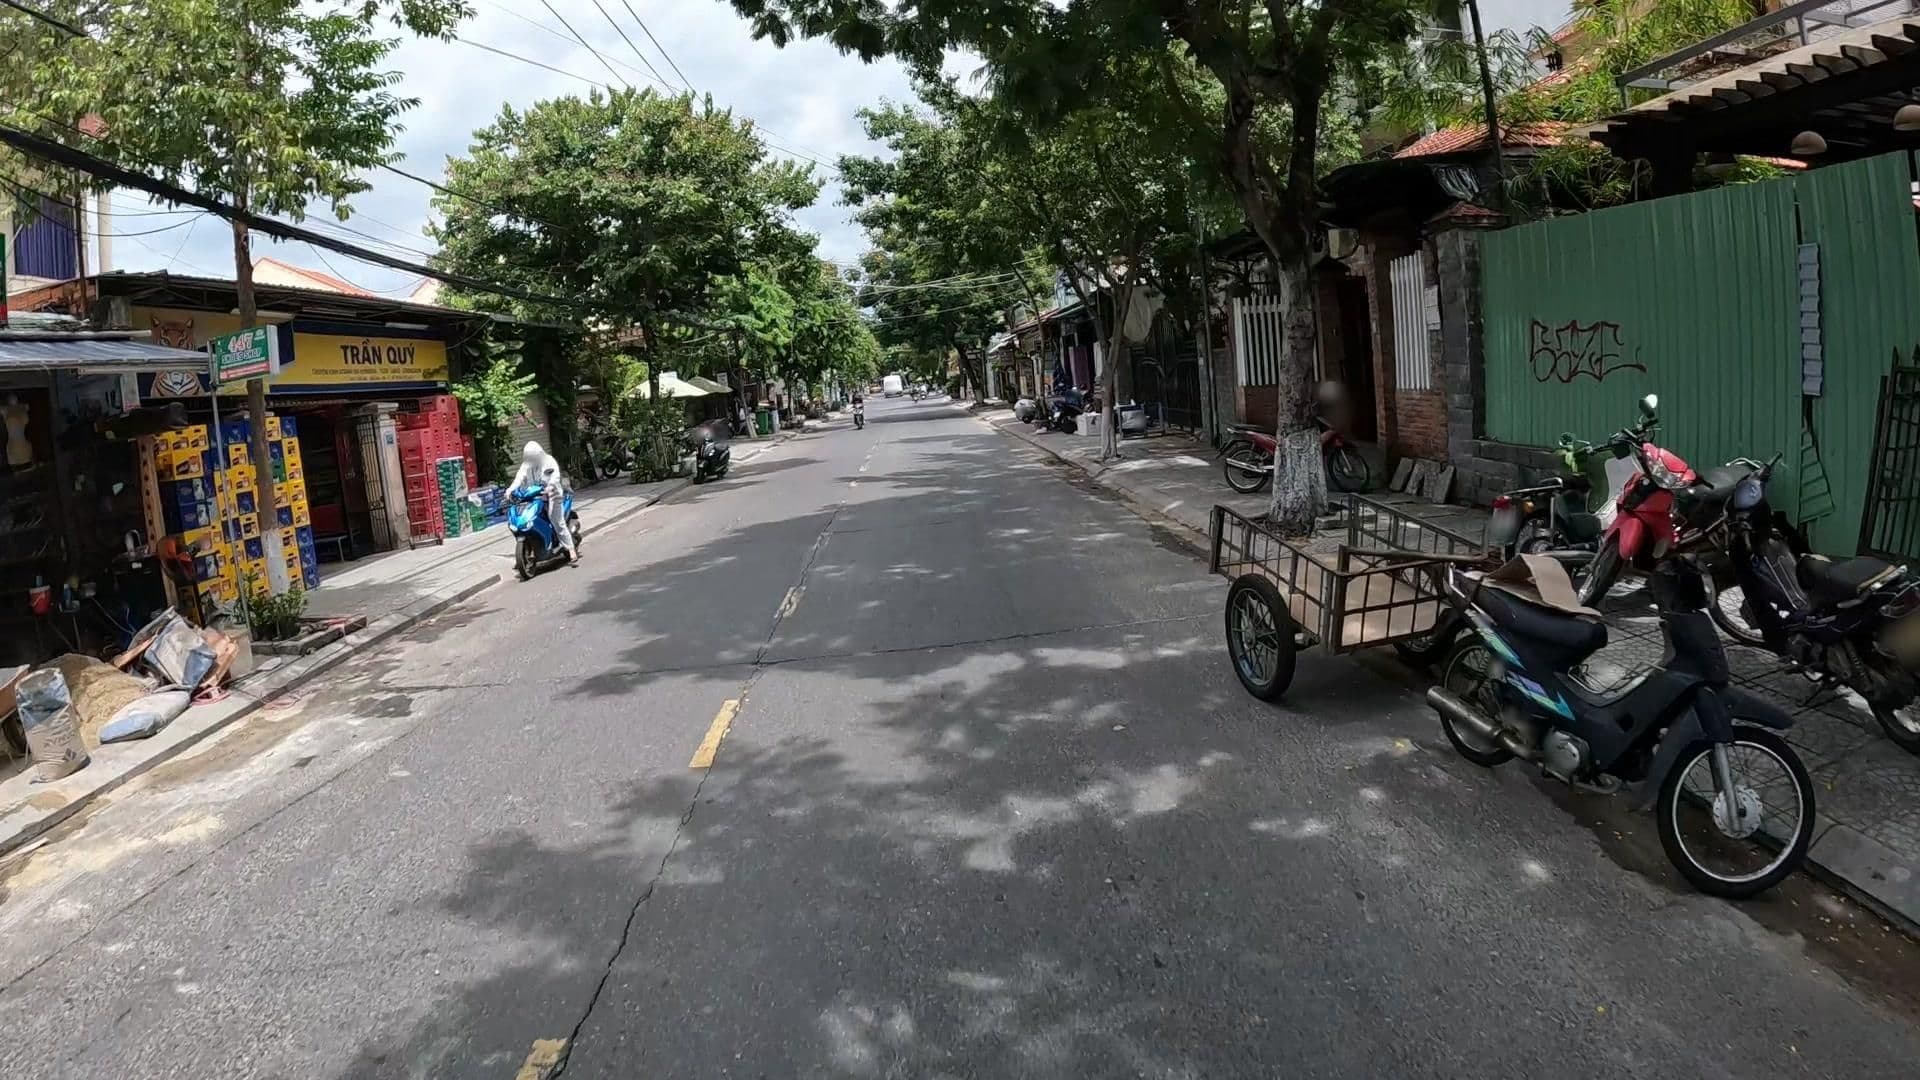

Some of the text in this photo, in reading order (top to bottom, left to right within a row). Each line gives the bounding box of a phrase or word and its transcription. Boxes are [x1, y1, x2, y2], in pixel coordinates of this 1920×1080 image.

[228, 332, 254, 353] 447
[340, 338, 415, 365] TRẦN QUÝ
